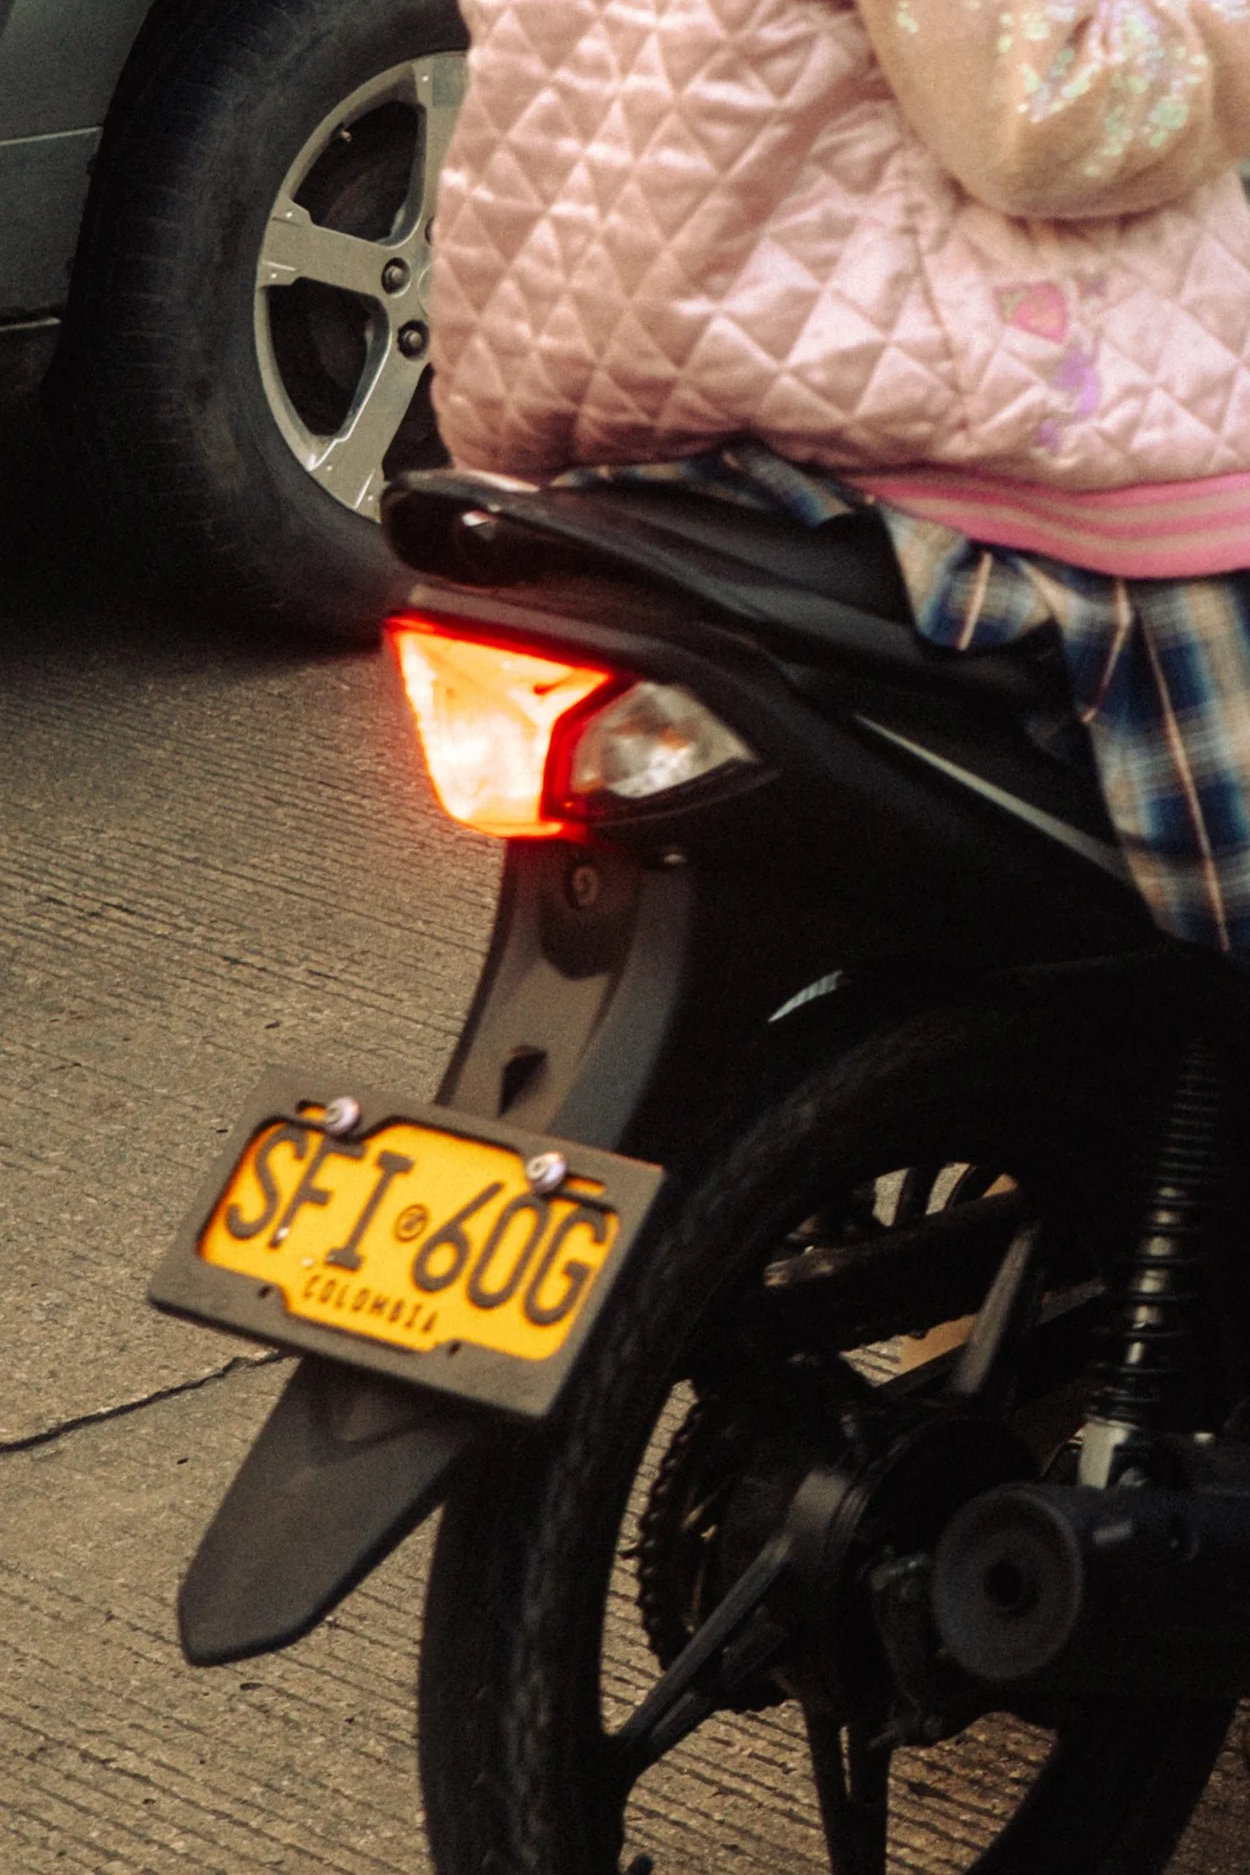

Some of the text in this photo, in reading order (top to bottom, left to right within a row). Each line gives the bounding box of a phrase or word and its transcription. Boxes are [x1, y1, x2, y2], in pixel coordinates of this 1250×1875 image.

[225, 1124, 610, 1327] SFI 60G
[302, 1275, 439, 1334] COLOMBIA
